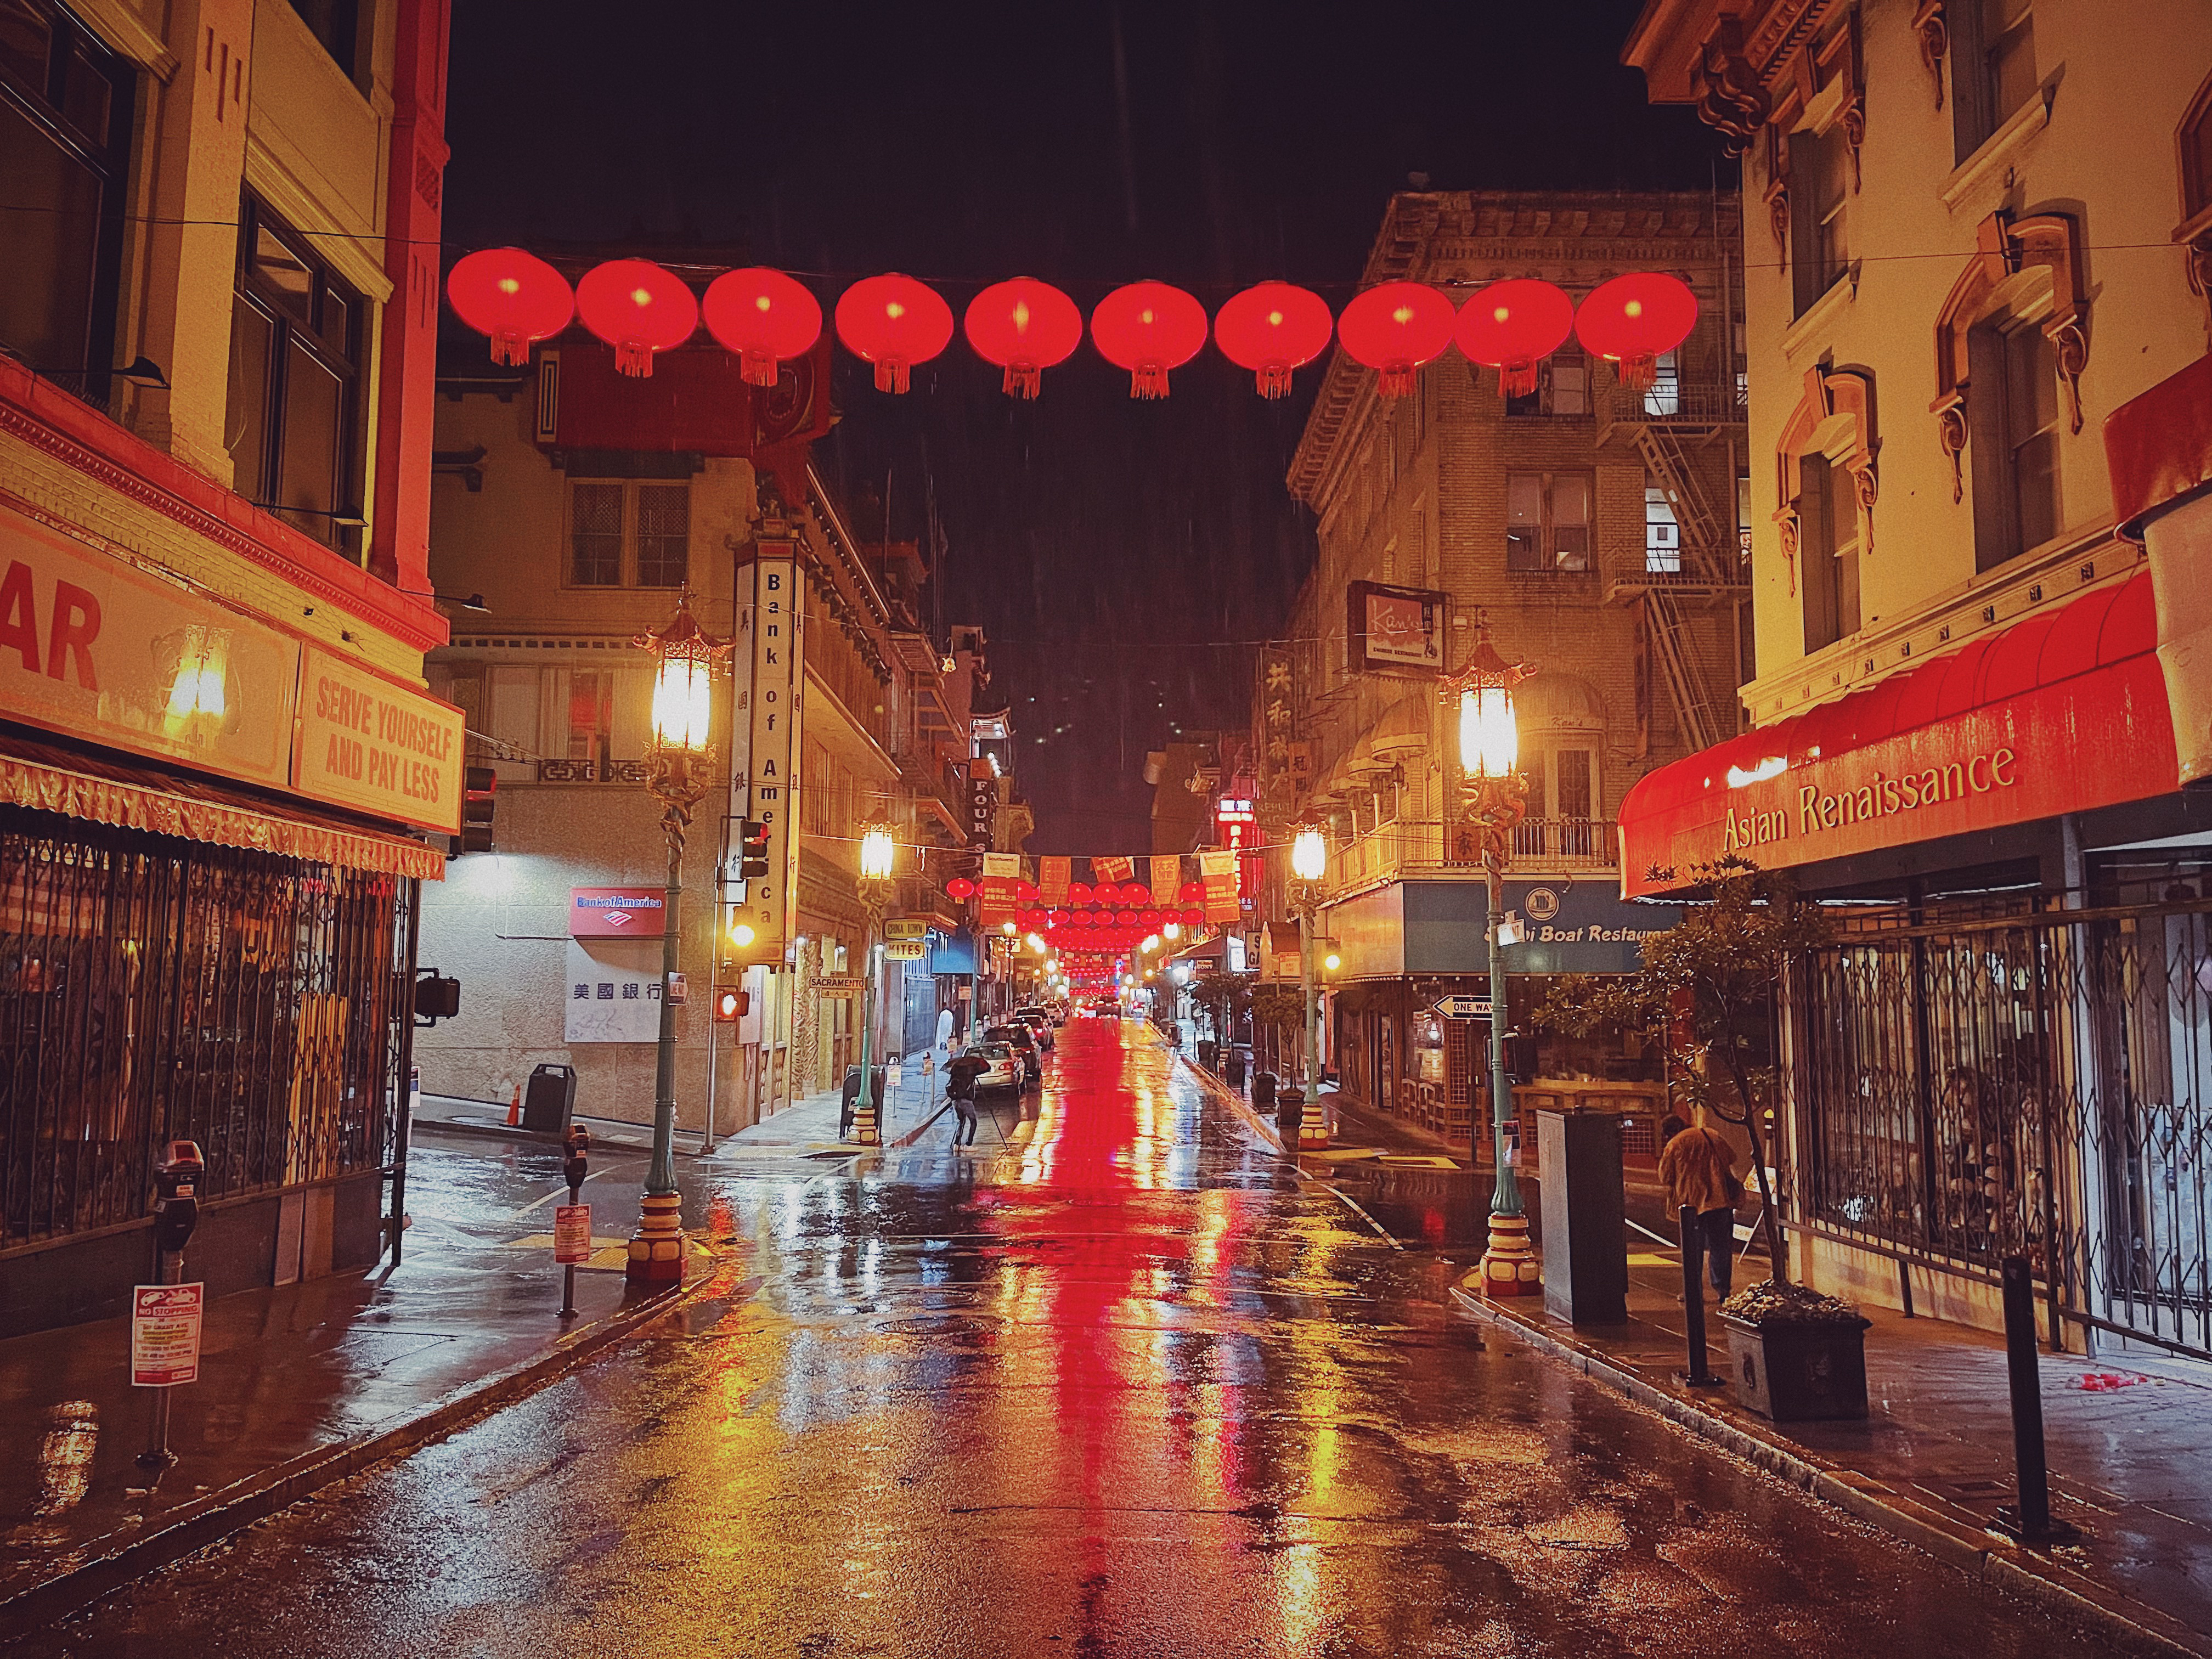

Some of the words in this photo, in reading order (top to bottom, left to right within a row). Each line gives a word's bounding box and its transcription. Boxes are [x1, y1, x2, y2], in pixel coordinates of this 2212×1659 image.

[766, 574, 781, 664] Bank
[316, 676, 373, 735] SERVE
[378, 700, 453, 763] YOURSELF
[766, 690, 777, 731] of
[325, 733, 363, 781] AND
[369, 749, 398, 791] PAY
[403, 760, 441, 804] LESS
[974, 781, 988, 833] FOUR
[1723, 808, 1788, 852] Asian
[1798, 748, 2016, 836] Renaissance
[759, 759, 777, 923] Ameca
[578, 896, 605, 908] Bank
[616, 895, 662, 908] America
[888, 923, 904, 934] CHINA
[907, 923, 922, 934] TOWN
[1539, 924, 1583, 943] Boat
[1588, 924, 1670, 943] Restaur
[888, 944, 921, 955] KITES
[573, 983, 662, 1000] 美國銀行
[811, 978, 864, 987] SACRAMENTO
[1453, 1003, 1473, 1012] ONE
[155, 1305, 198, 1315] STOPPING
